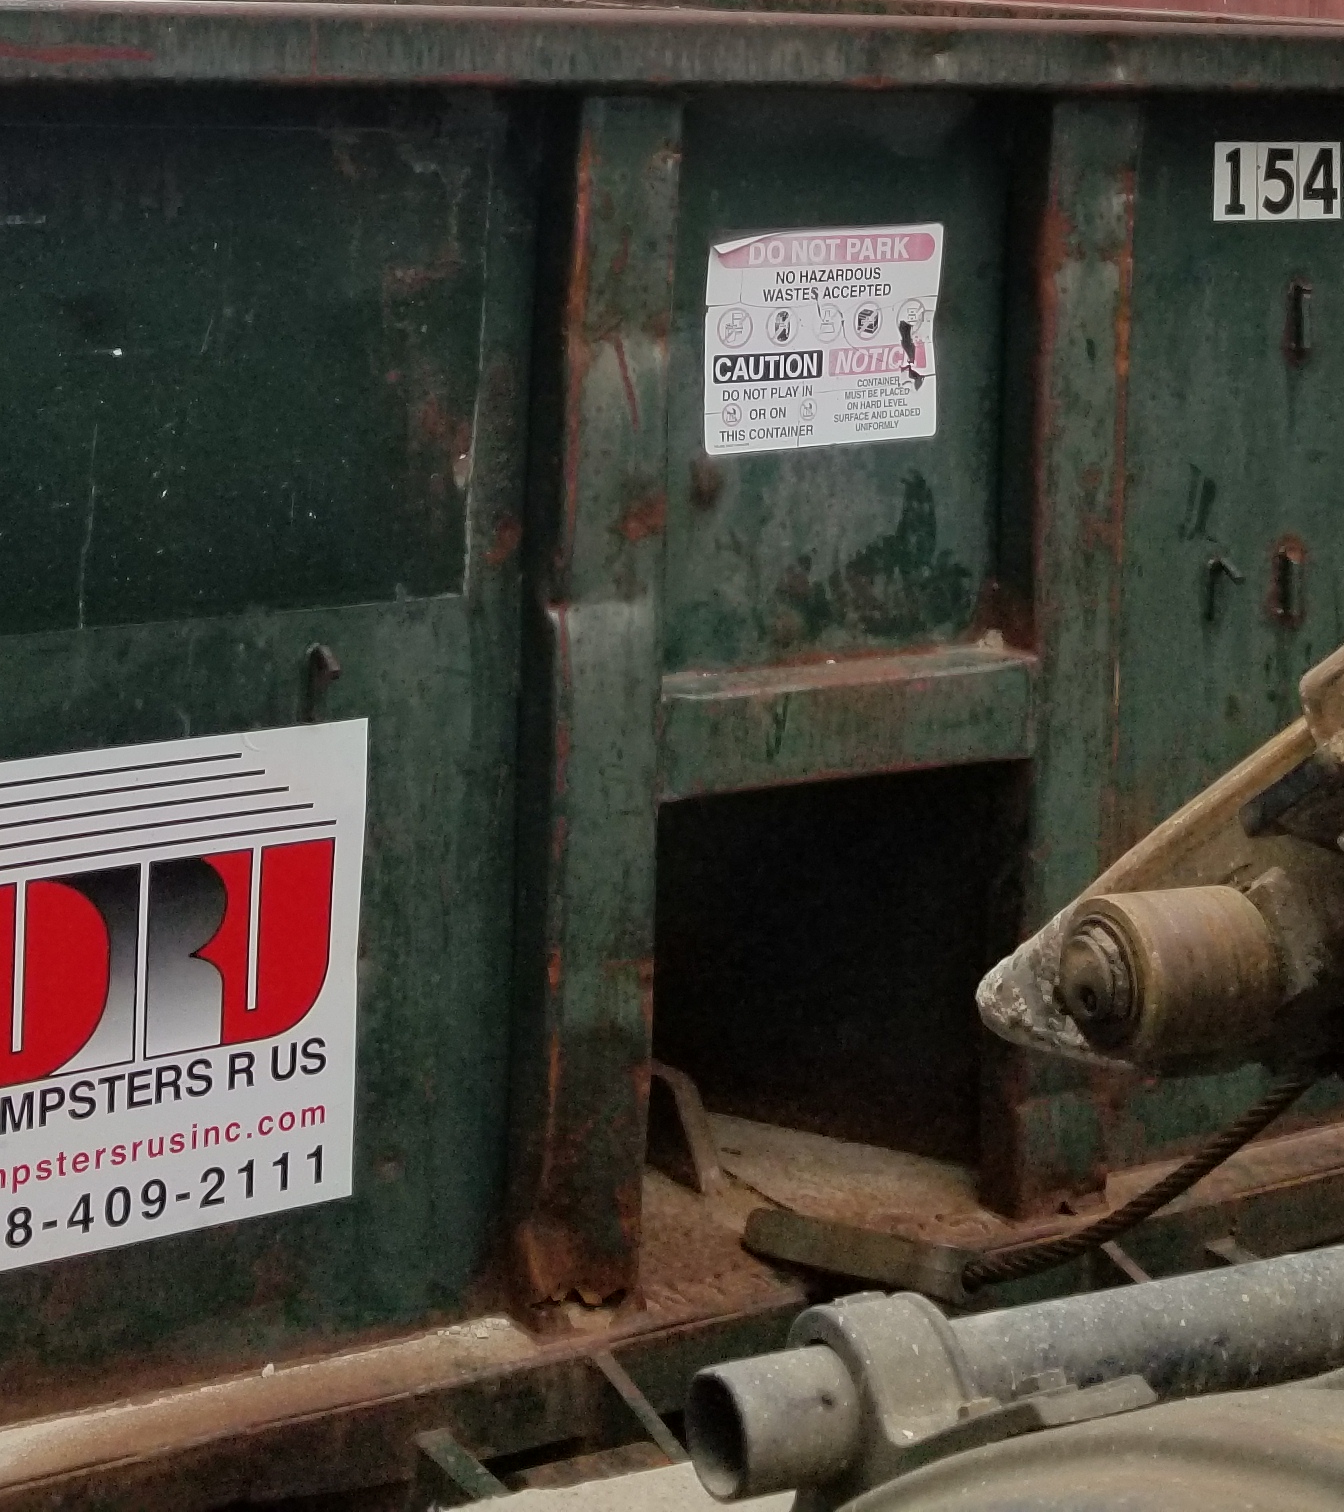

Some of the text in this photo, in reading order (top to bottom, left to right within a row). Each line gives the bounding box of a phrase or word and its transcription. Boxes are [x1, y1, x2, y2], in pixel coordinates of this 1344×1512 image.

[1224, 147, 1339, 215] 154
[748, 236, 910, 265] DO NOT PARK
[775, 267, 881, 285] NO HAZARDOUS
[763, 283, 892, 302] WASTES ACCEPTED
[714, 352, 818, 382] CAUTION
[857, 375, 900, 388] CONTAINER
[722, 384, 813, 402] DO NOT PLAY IN
[844, 387, 910, 400] MUST BE PLACED
[749, 406, 787, 421] OR ON
[846, 398, 908, 411] ON HARD LEVEL
[833, 407, 921, 423] SURFACE AND LOADED
[719, 424, 814, 443] THIS CONTAINER
[855, 419, 900, 432] UNIFORMLY
[227, 1051, 256, 1092] R
[270, 1036, 328, 1082] US
